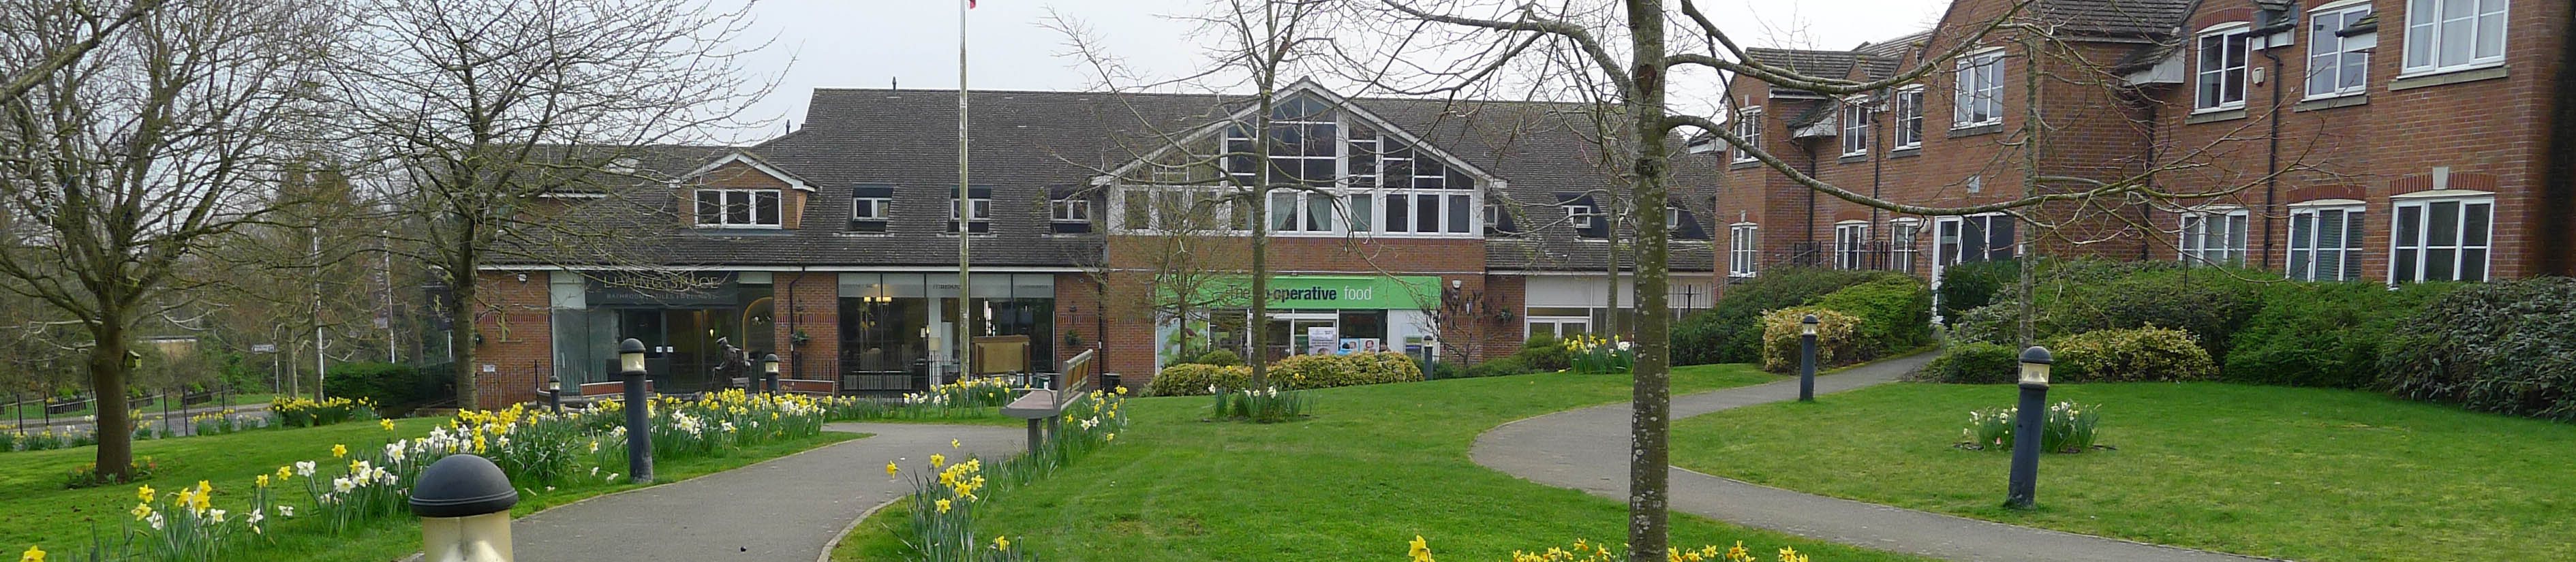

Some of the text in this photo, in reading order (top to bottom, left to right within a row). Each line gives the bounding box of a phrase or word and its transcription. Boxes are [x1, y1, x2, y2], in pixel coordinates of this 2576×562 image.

[604, 276, 719, 289] LIVING SPACE
[1265, 286, 1337, 302] -operative
[1344, 286, 1372, 300] food
